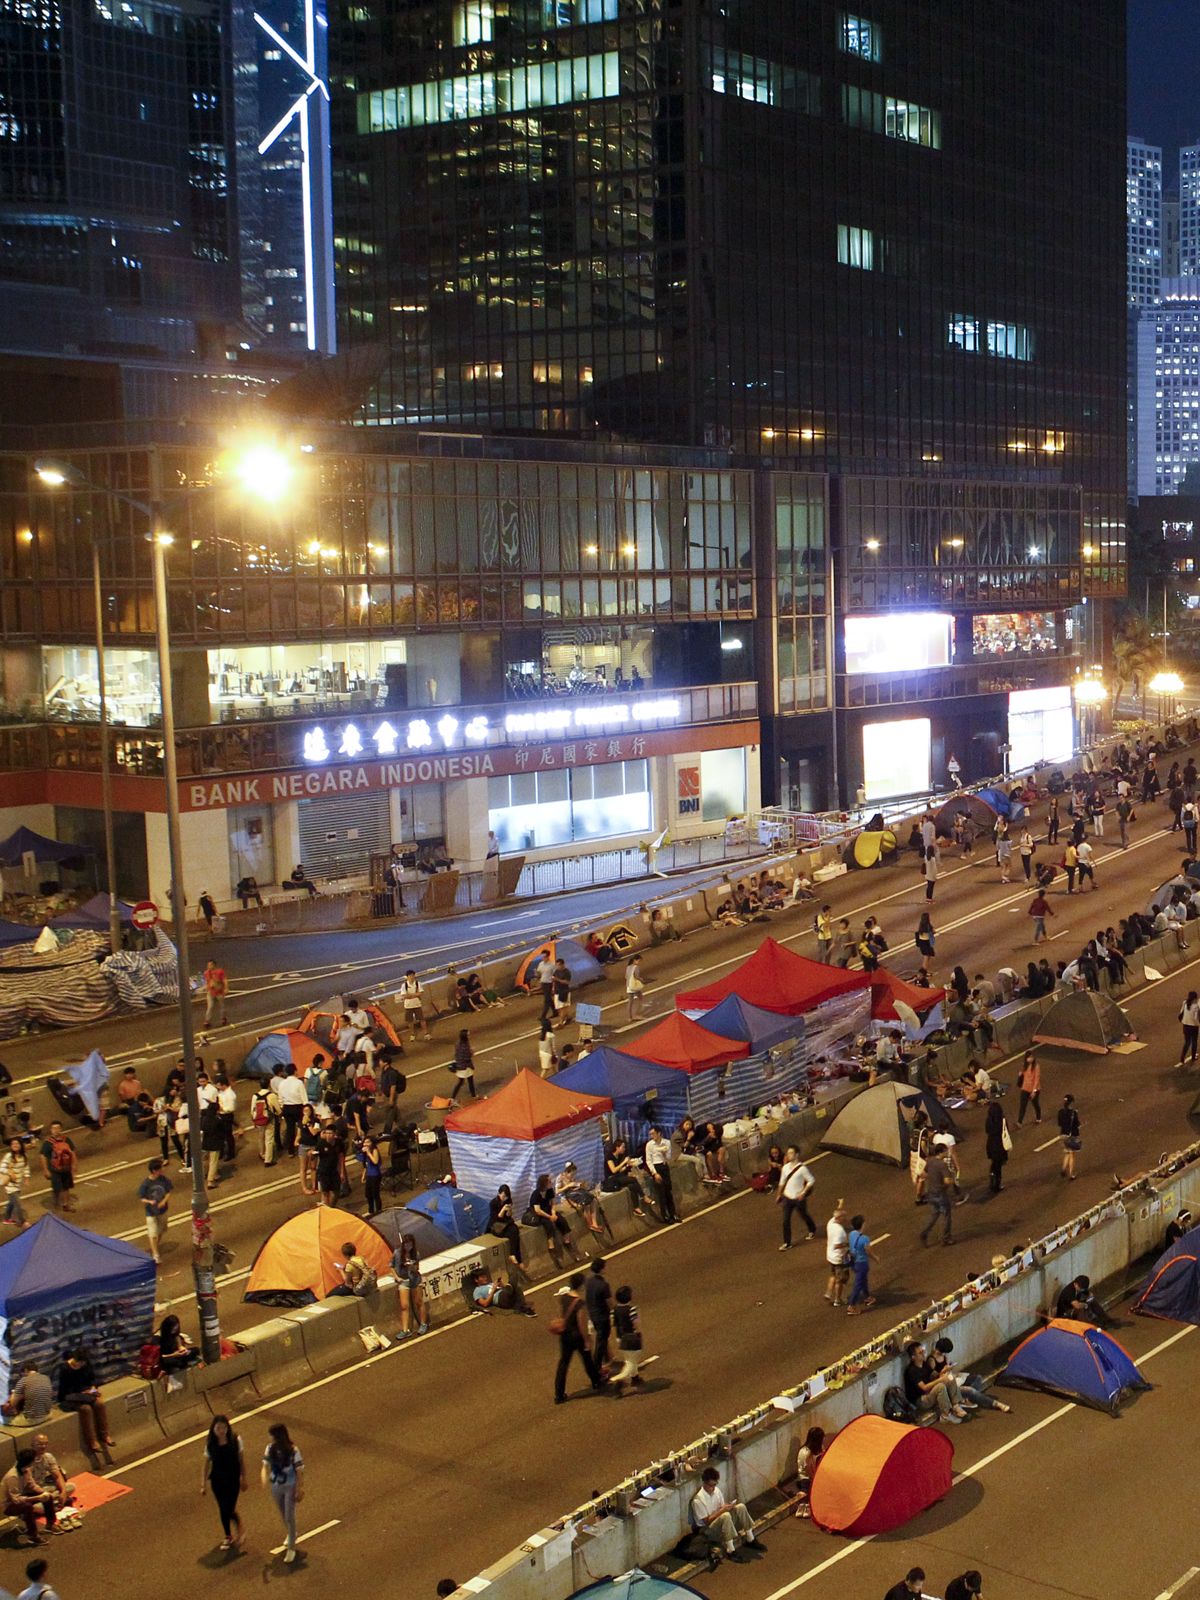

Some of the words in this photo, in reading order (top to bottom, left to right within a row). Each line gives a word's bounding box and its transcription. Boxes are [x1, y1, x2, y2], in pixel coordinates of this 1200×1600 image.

[515, 737, 646, 769] 印尼國家銀行
[191, 779, 260, 807] BANK
[273, 768, 369, 798] NEGARA
[380, 754, 494, 786] INDONESIA
[679, 798, 700, 814] BNI
